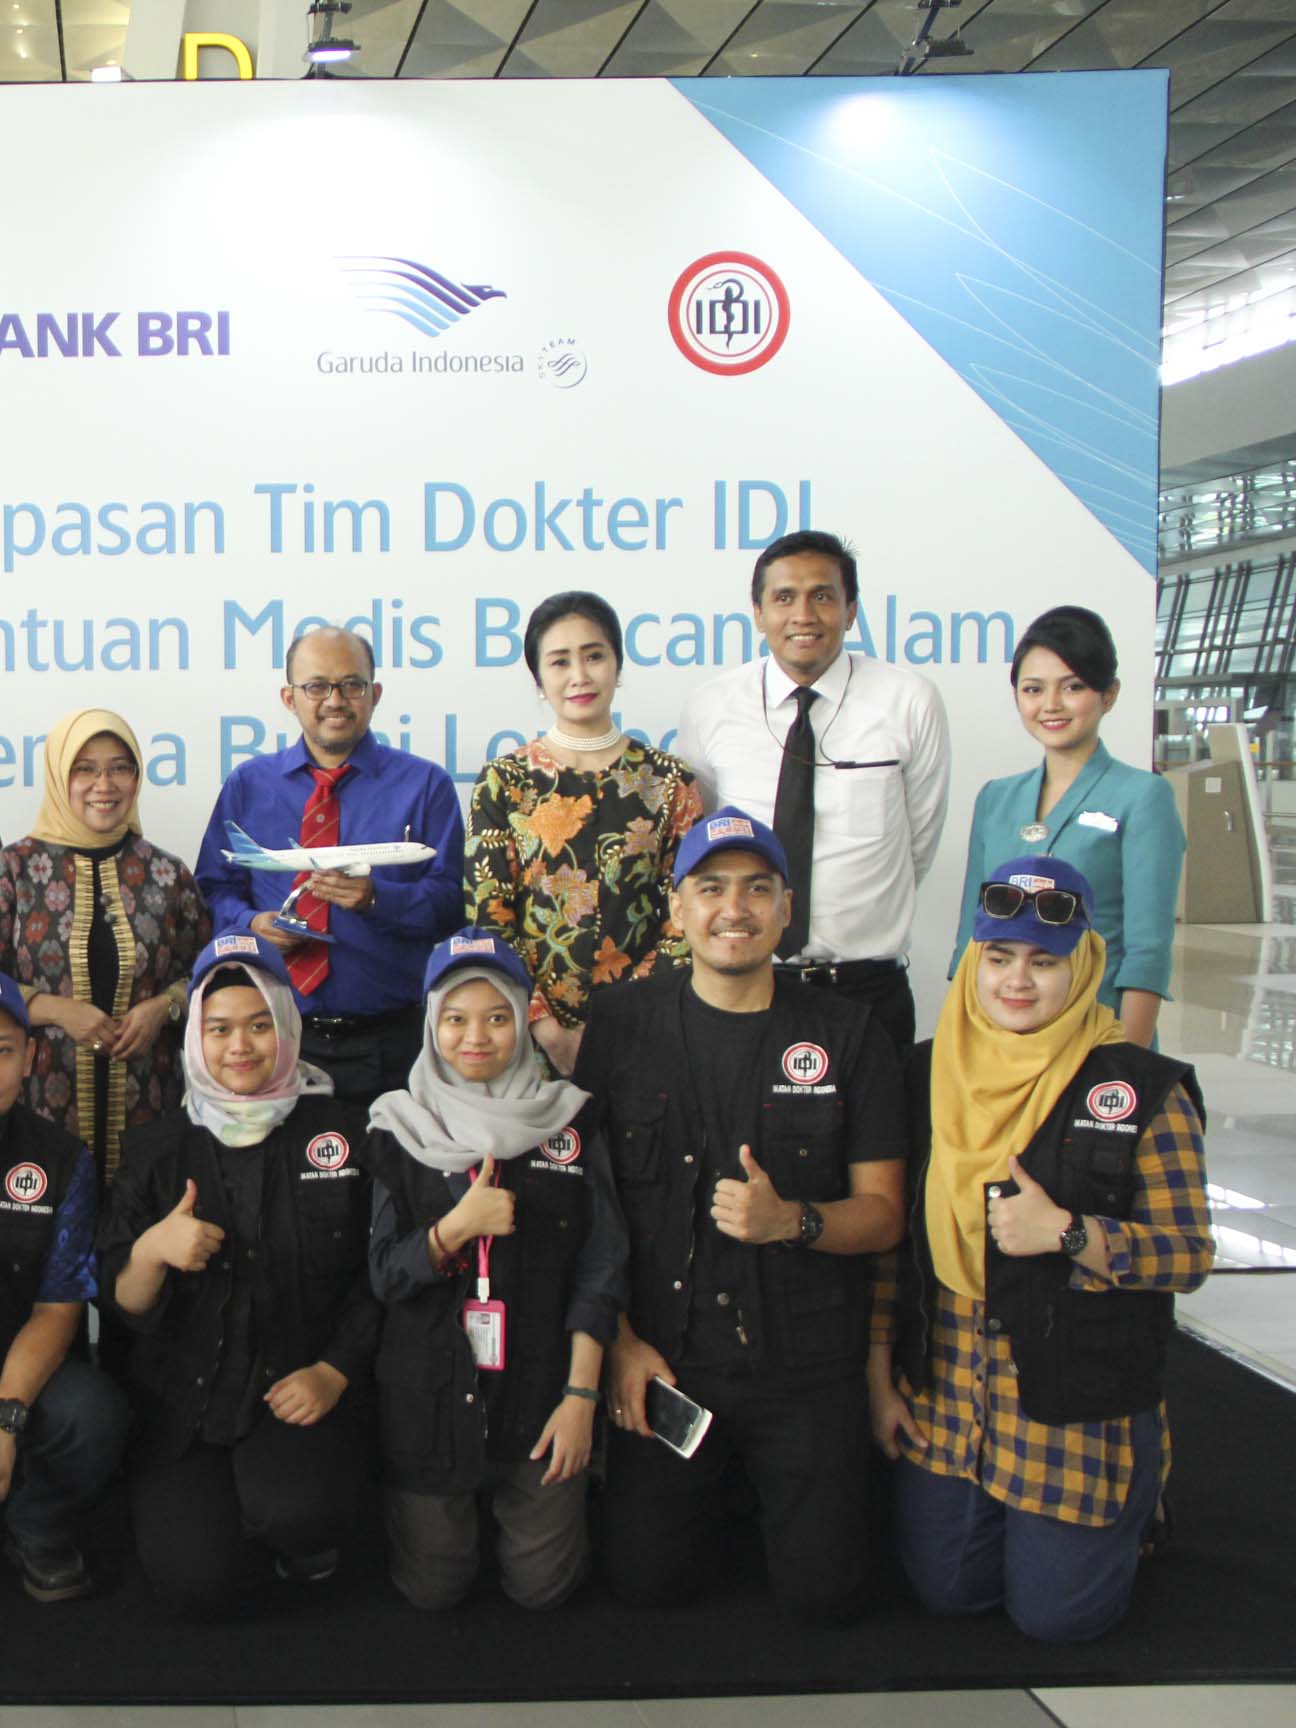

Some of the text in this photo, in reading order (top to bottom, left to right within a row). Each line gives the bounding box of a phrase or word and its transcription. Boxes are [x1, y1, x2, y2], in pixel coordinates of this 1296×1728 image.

[137, 311, 230, 357] BRI
[317, 350, 524, 374] Garuda Indonesia
[253, 482, 390, 554] Tim
[423, 480, 684, 553] Dokter
[713, 479, 812, 551] IDI
